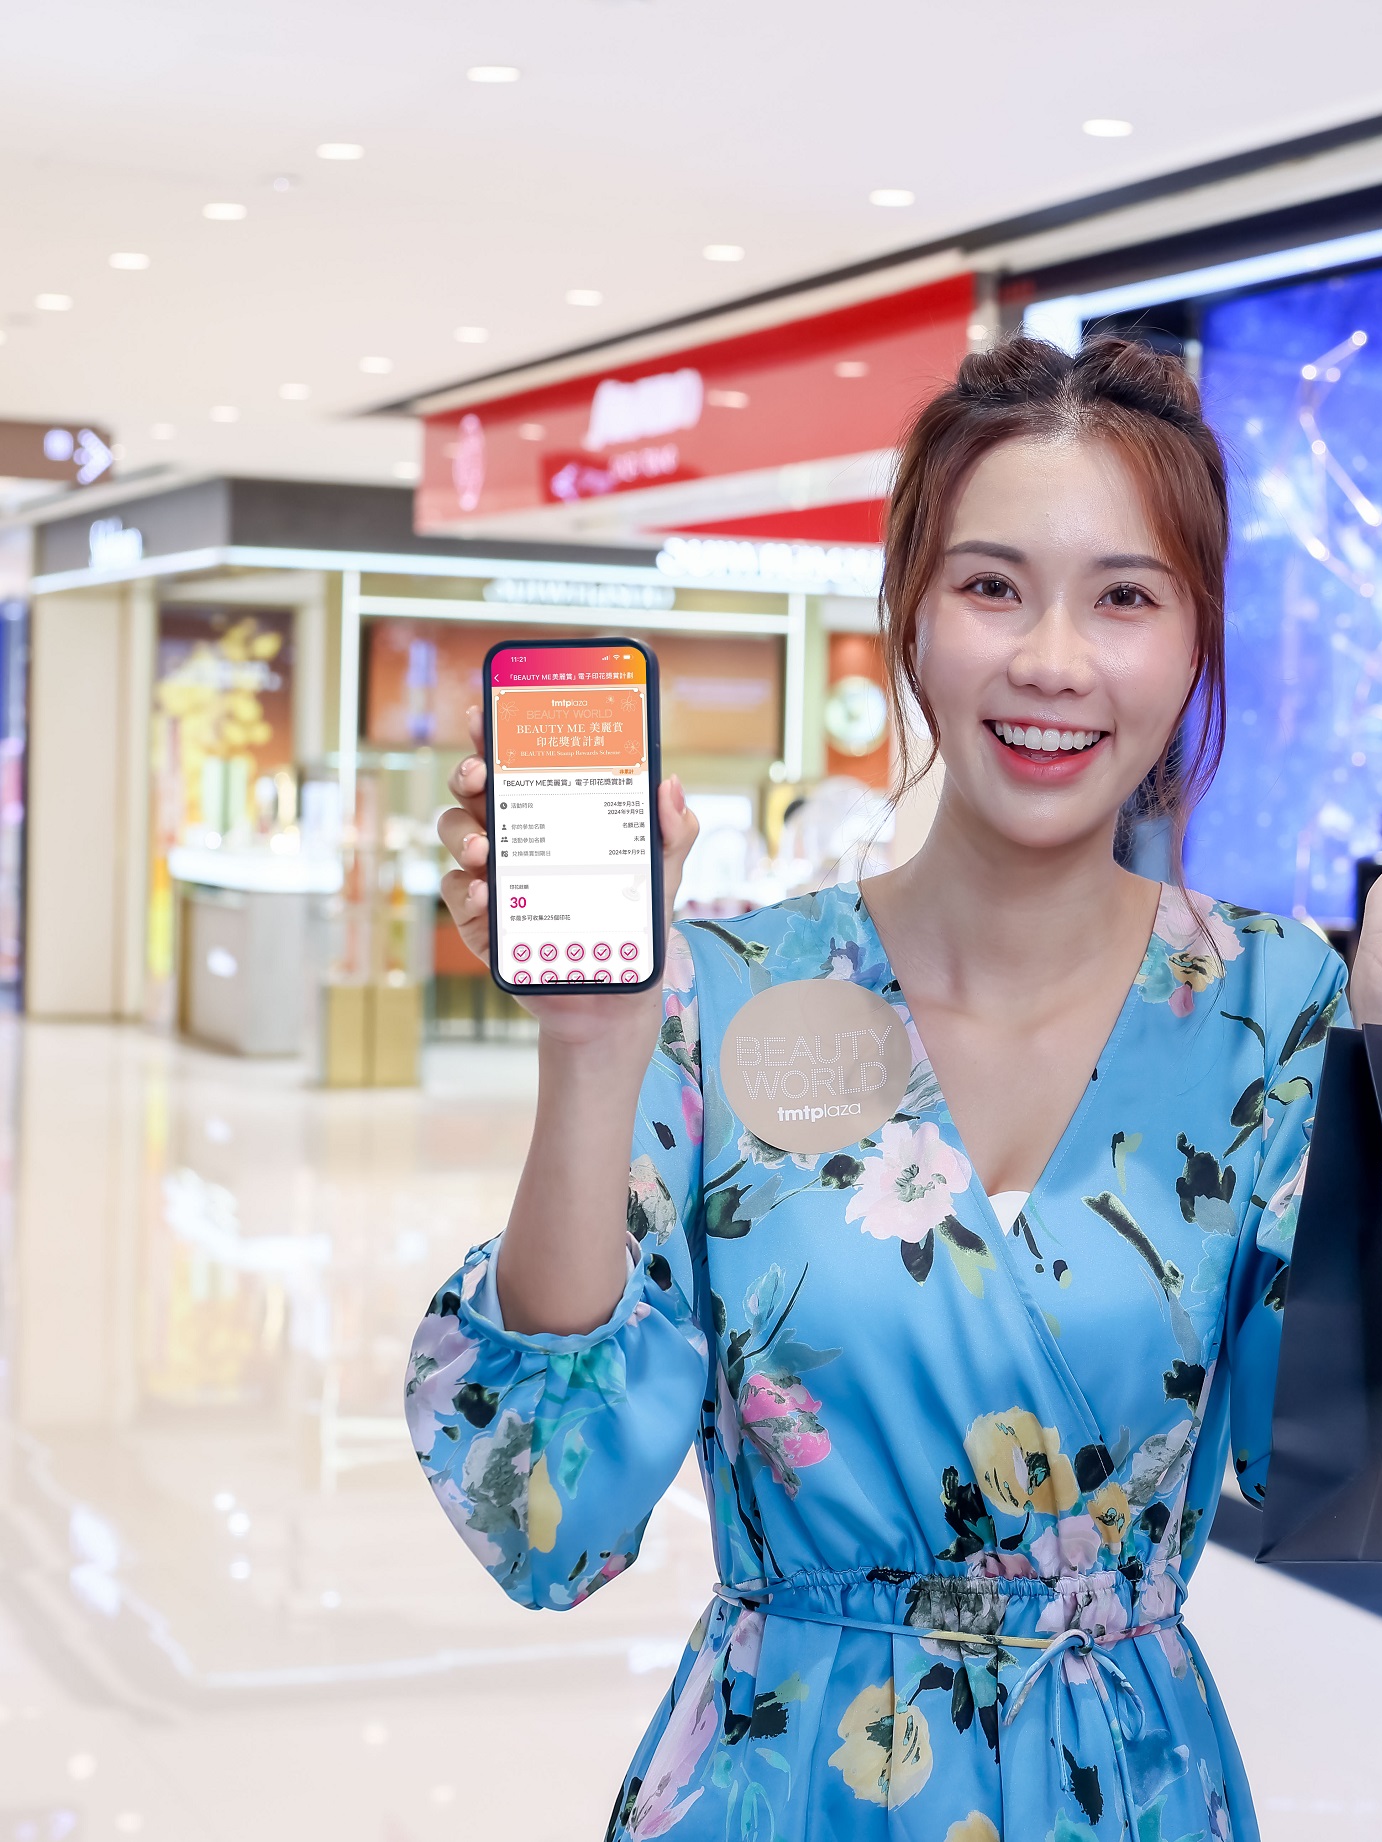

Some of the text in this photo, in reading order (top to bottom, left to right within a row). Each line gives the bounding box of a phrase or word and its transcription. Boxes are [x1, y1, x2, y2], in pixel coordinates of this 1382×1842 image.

[551, 699, 588, 708] tmtplaza
[526, 709, 613, 720] BEAUTY WORLD
[516, 722, 623, 734] BEAUTY ME 美麗賞
[509, 896, 527, 909] 30
[736, 1025, 892, 1067] BEAUTY
[742, 1061, 888, 1101] WORLD
[777, 1102, 861, 1123] tmtplaza
